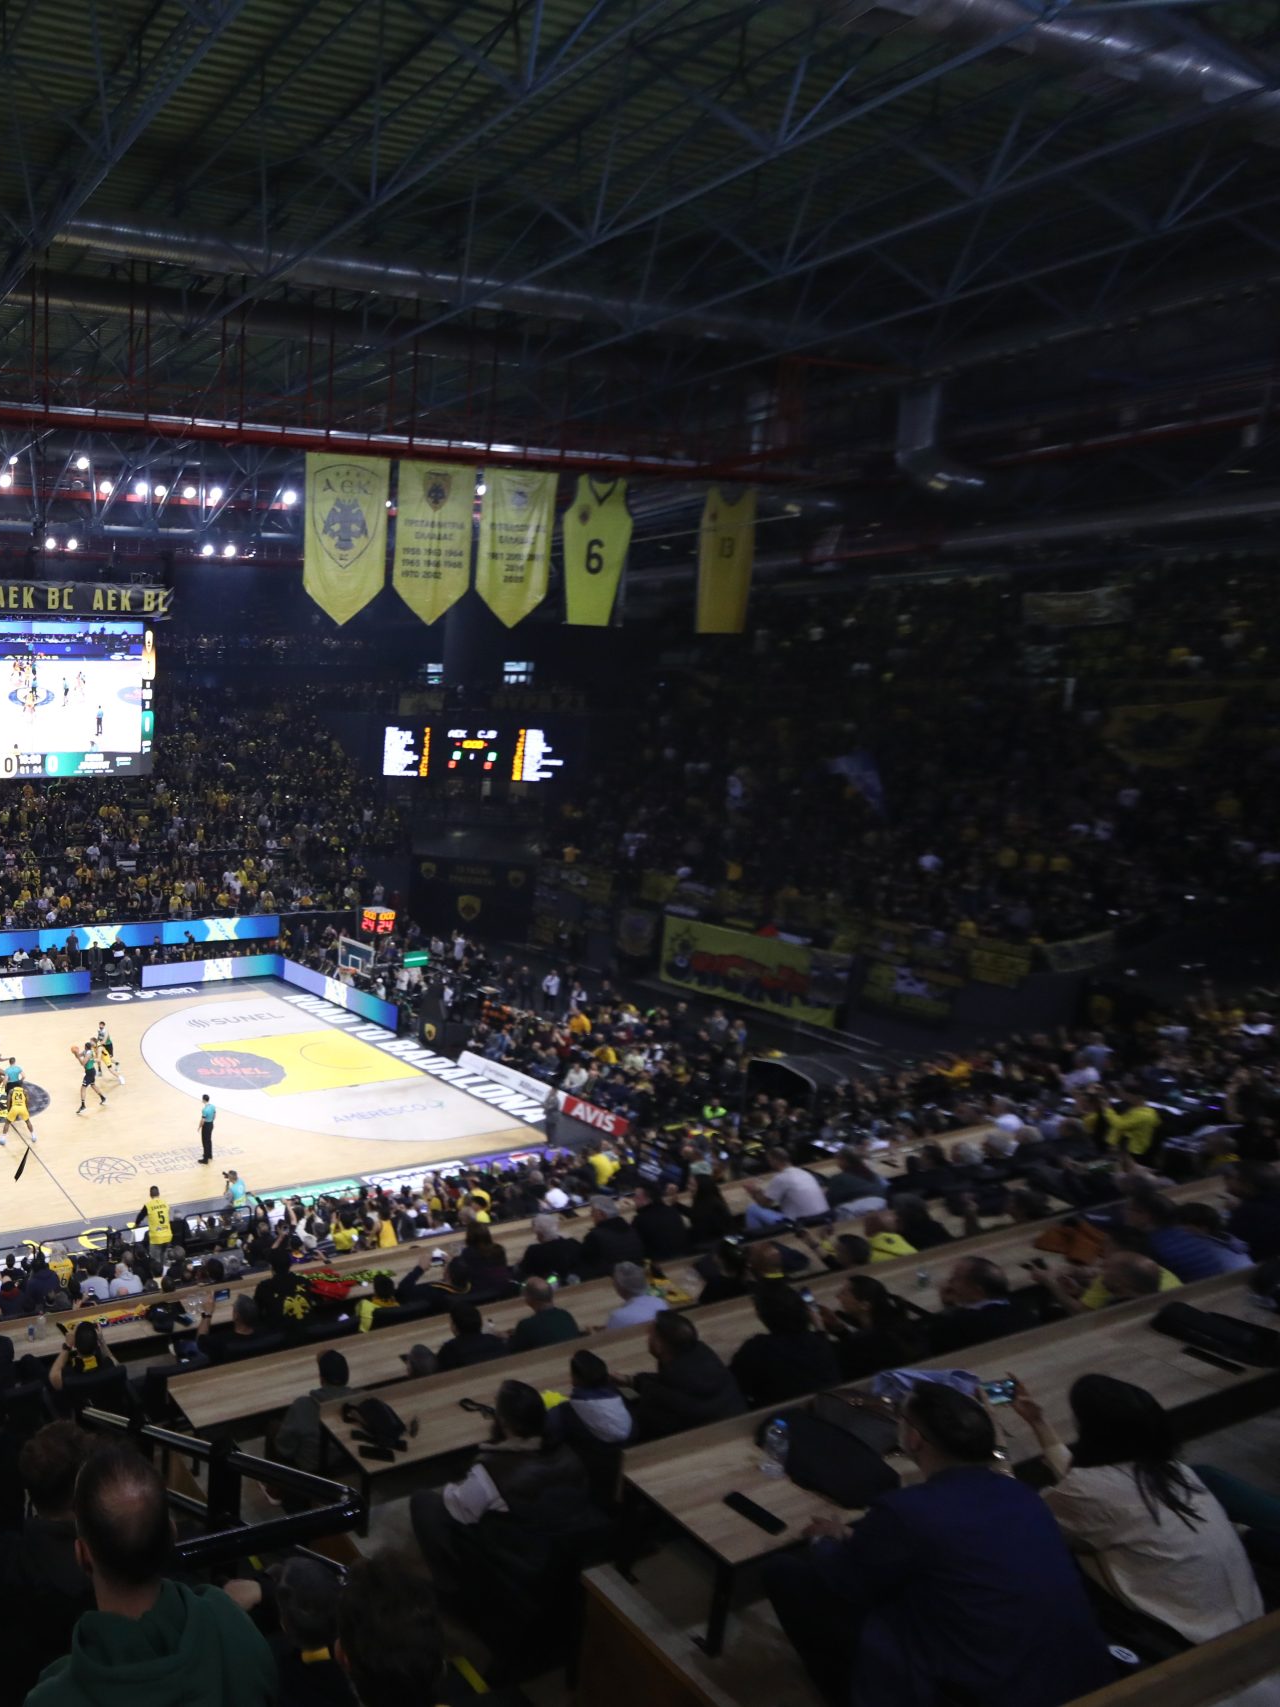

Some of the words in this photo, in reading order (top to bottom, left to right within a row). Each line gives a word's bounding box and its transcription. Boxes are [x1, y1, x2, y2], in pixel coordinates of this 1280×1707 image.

[585, 539, 605, 574] 6
[47, 587, 74, 610] BC
[92, 588, 132, 611] AEK
[143, 590, 168, 612] BC
[5, 757, 13, 773] 0
[361, 917, 375, 932] 24
[377, 920, 394, 933] 24
[134, 986, 200, 999] green
[210, 1011, 286, 1025] SUNEL
[282, 993, 362, 1025] ROAD
[345, 1022, 398, 1042] TO
[376, 1039, 547, 1123] BADALONA
[14, 1092, 23, 1101] 24
[571, 1103, 617, 1133] AVIS
[157, 1210, 165, 1224] 5
